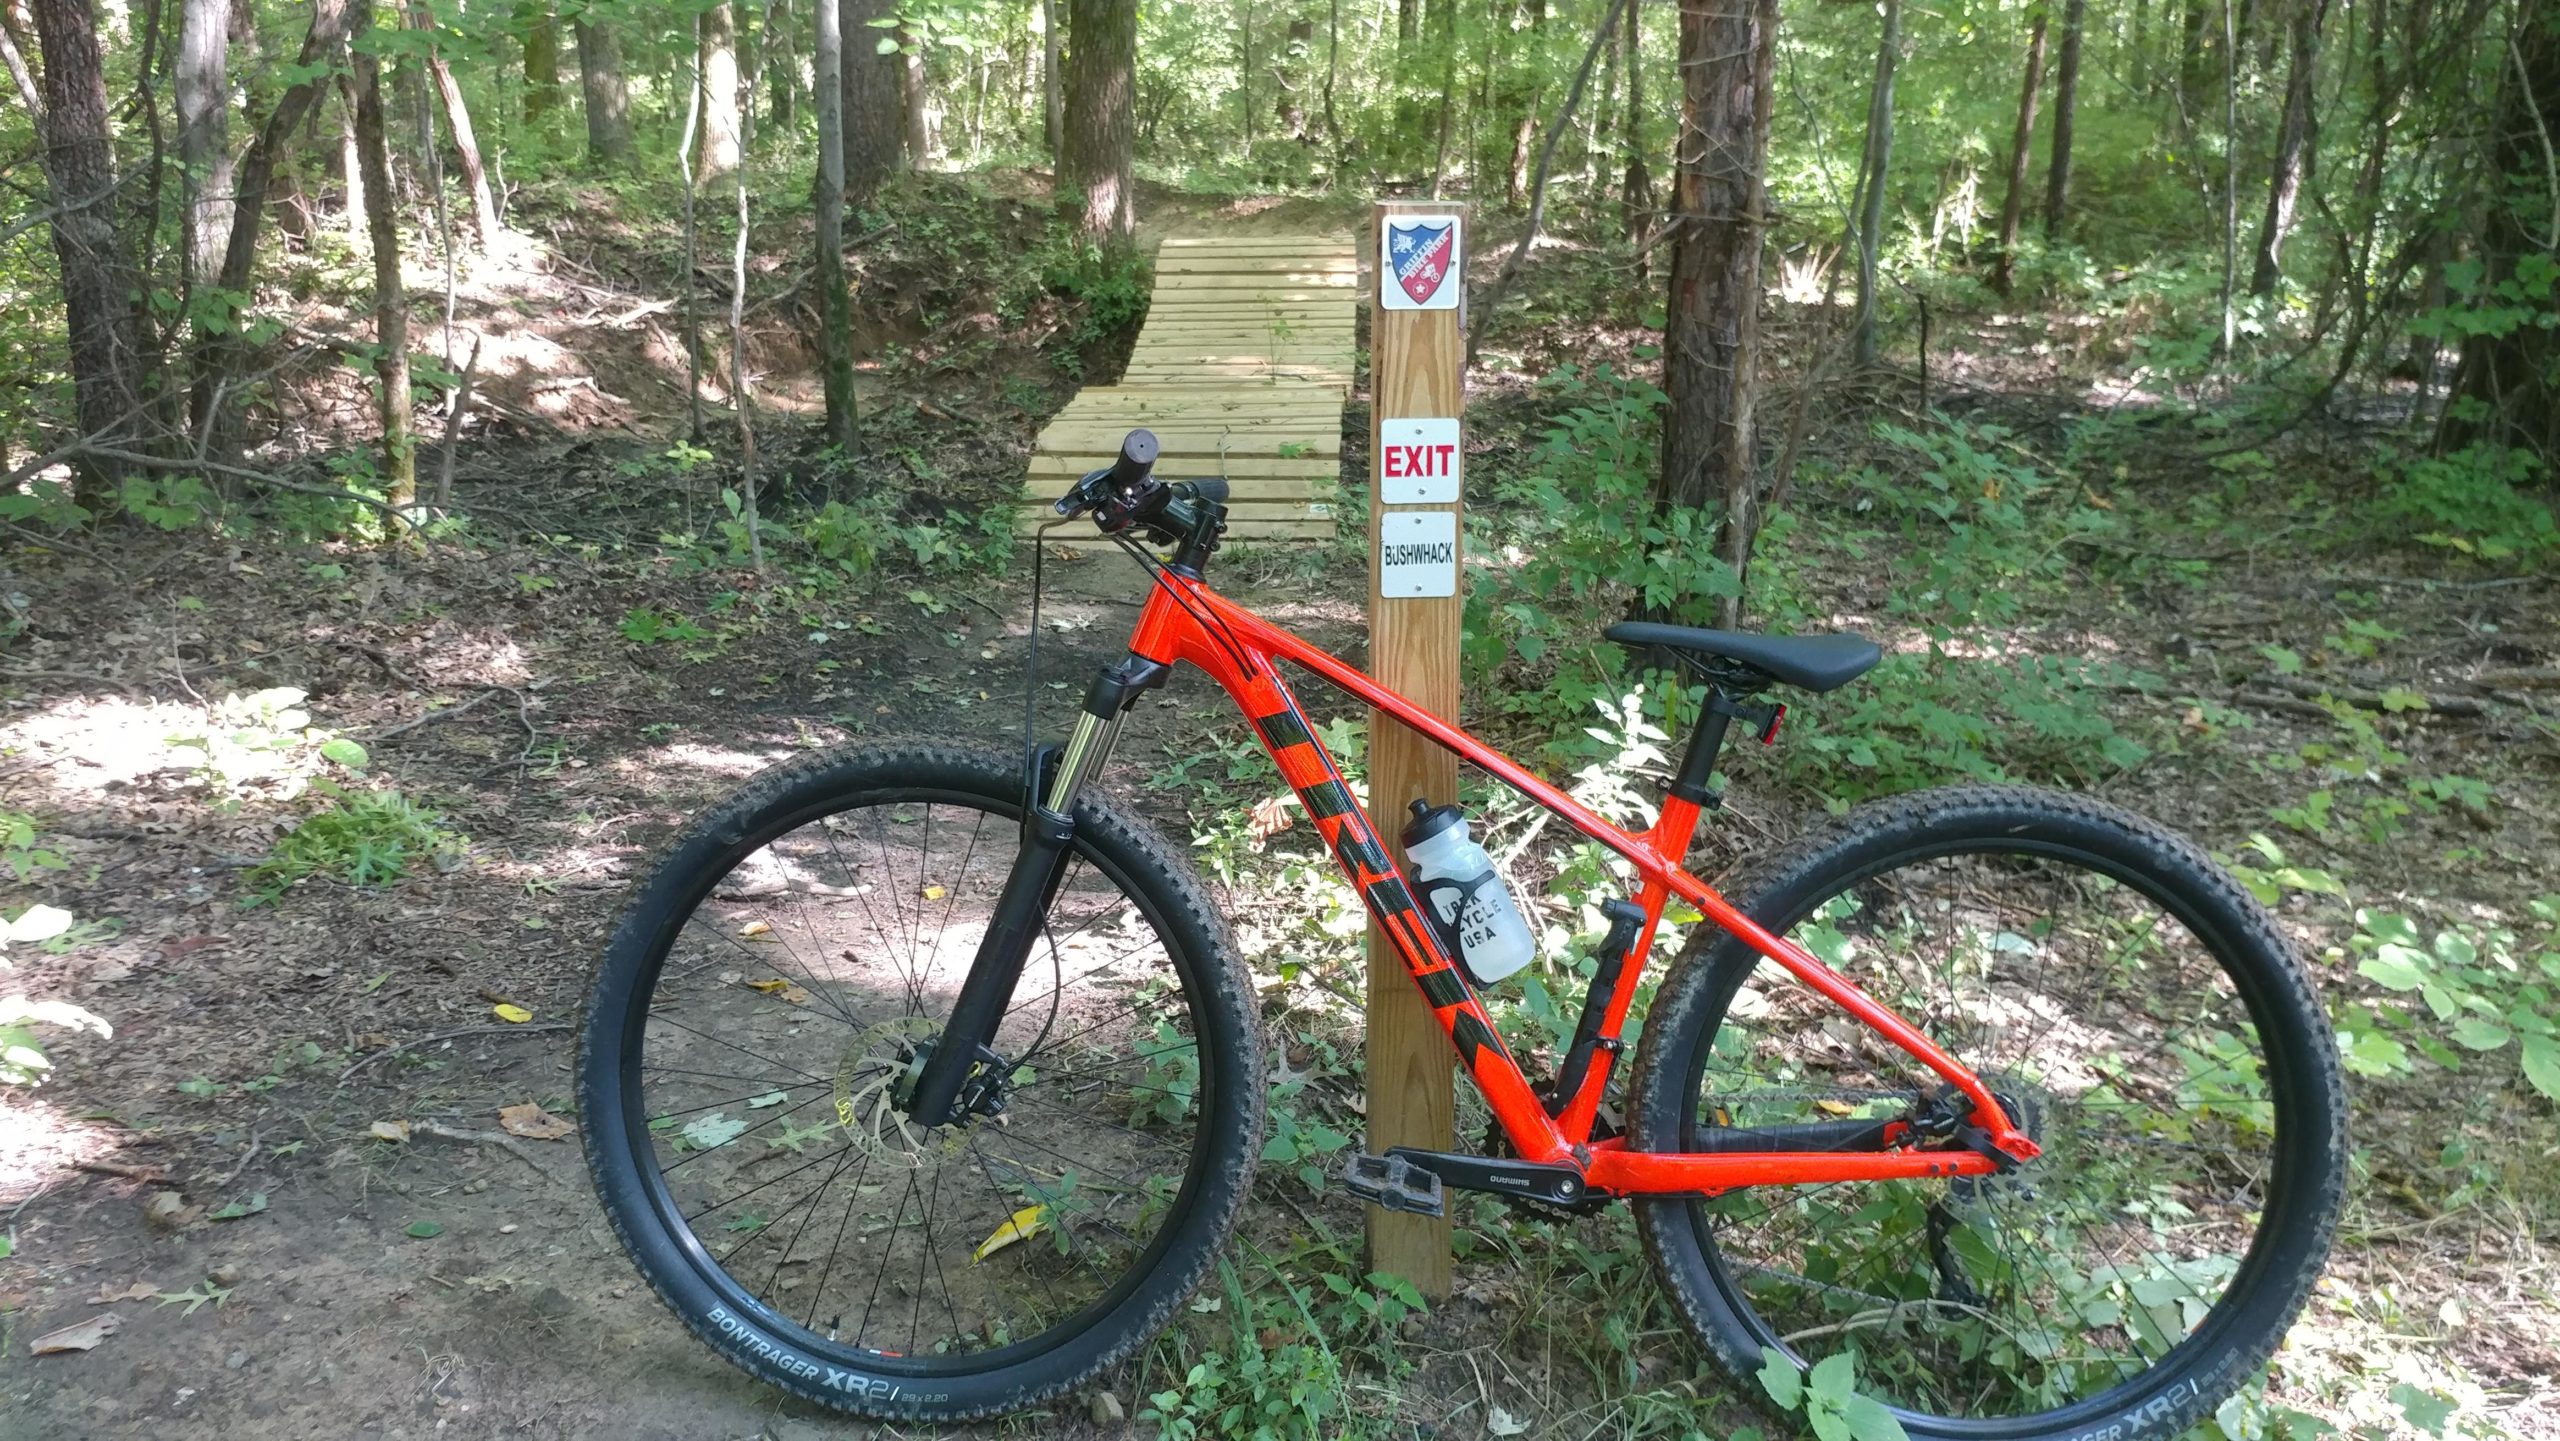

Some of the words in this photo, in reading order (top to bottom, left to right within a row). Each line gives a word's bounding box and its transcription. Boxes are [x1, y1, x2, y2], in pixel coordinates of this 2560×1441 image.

[1399, 238, 1434, 276] GRIFFIN
[1408, 255, 1429, 279] BIKE
[1427, 235, 1449, 259] PARK
[1385, 445, 1455, 478] EXIT
[1385, 542, 1453, 566] BUSHWHACK
[1256, 672, 1511, 1072] TREK
[1443, 893, 1481, 917] TRK
[1464, 926, 1496, 948] USA
[1490, 1175, 1530, 1186] SHIMANO
[706, 1307, 820, 1381] BONTRAGER
